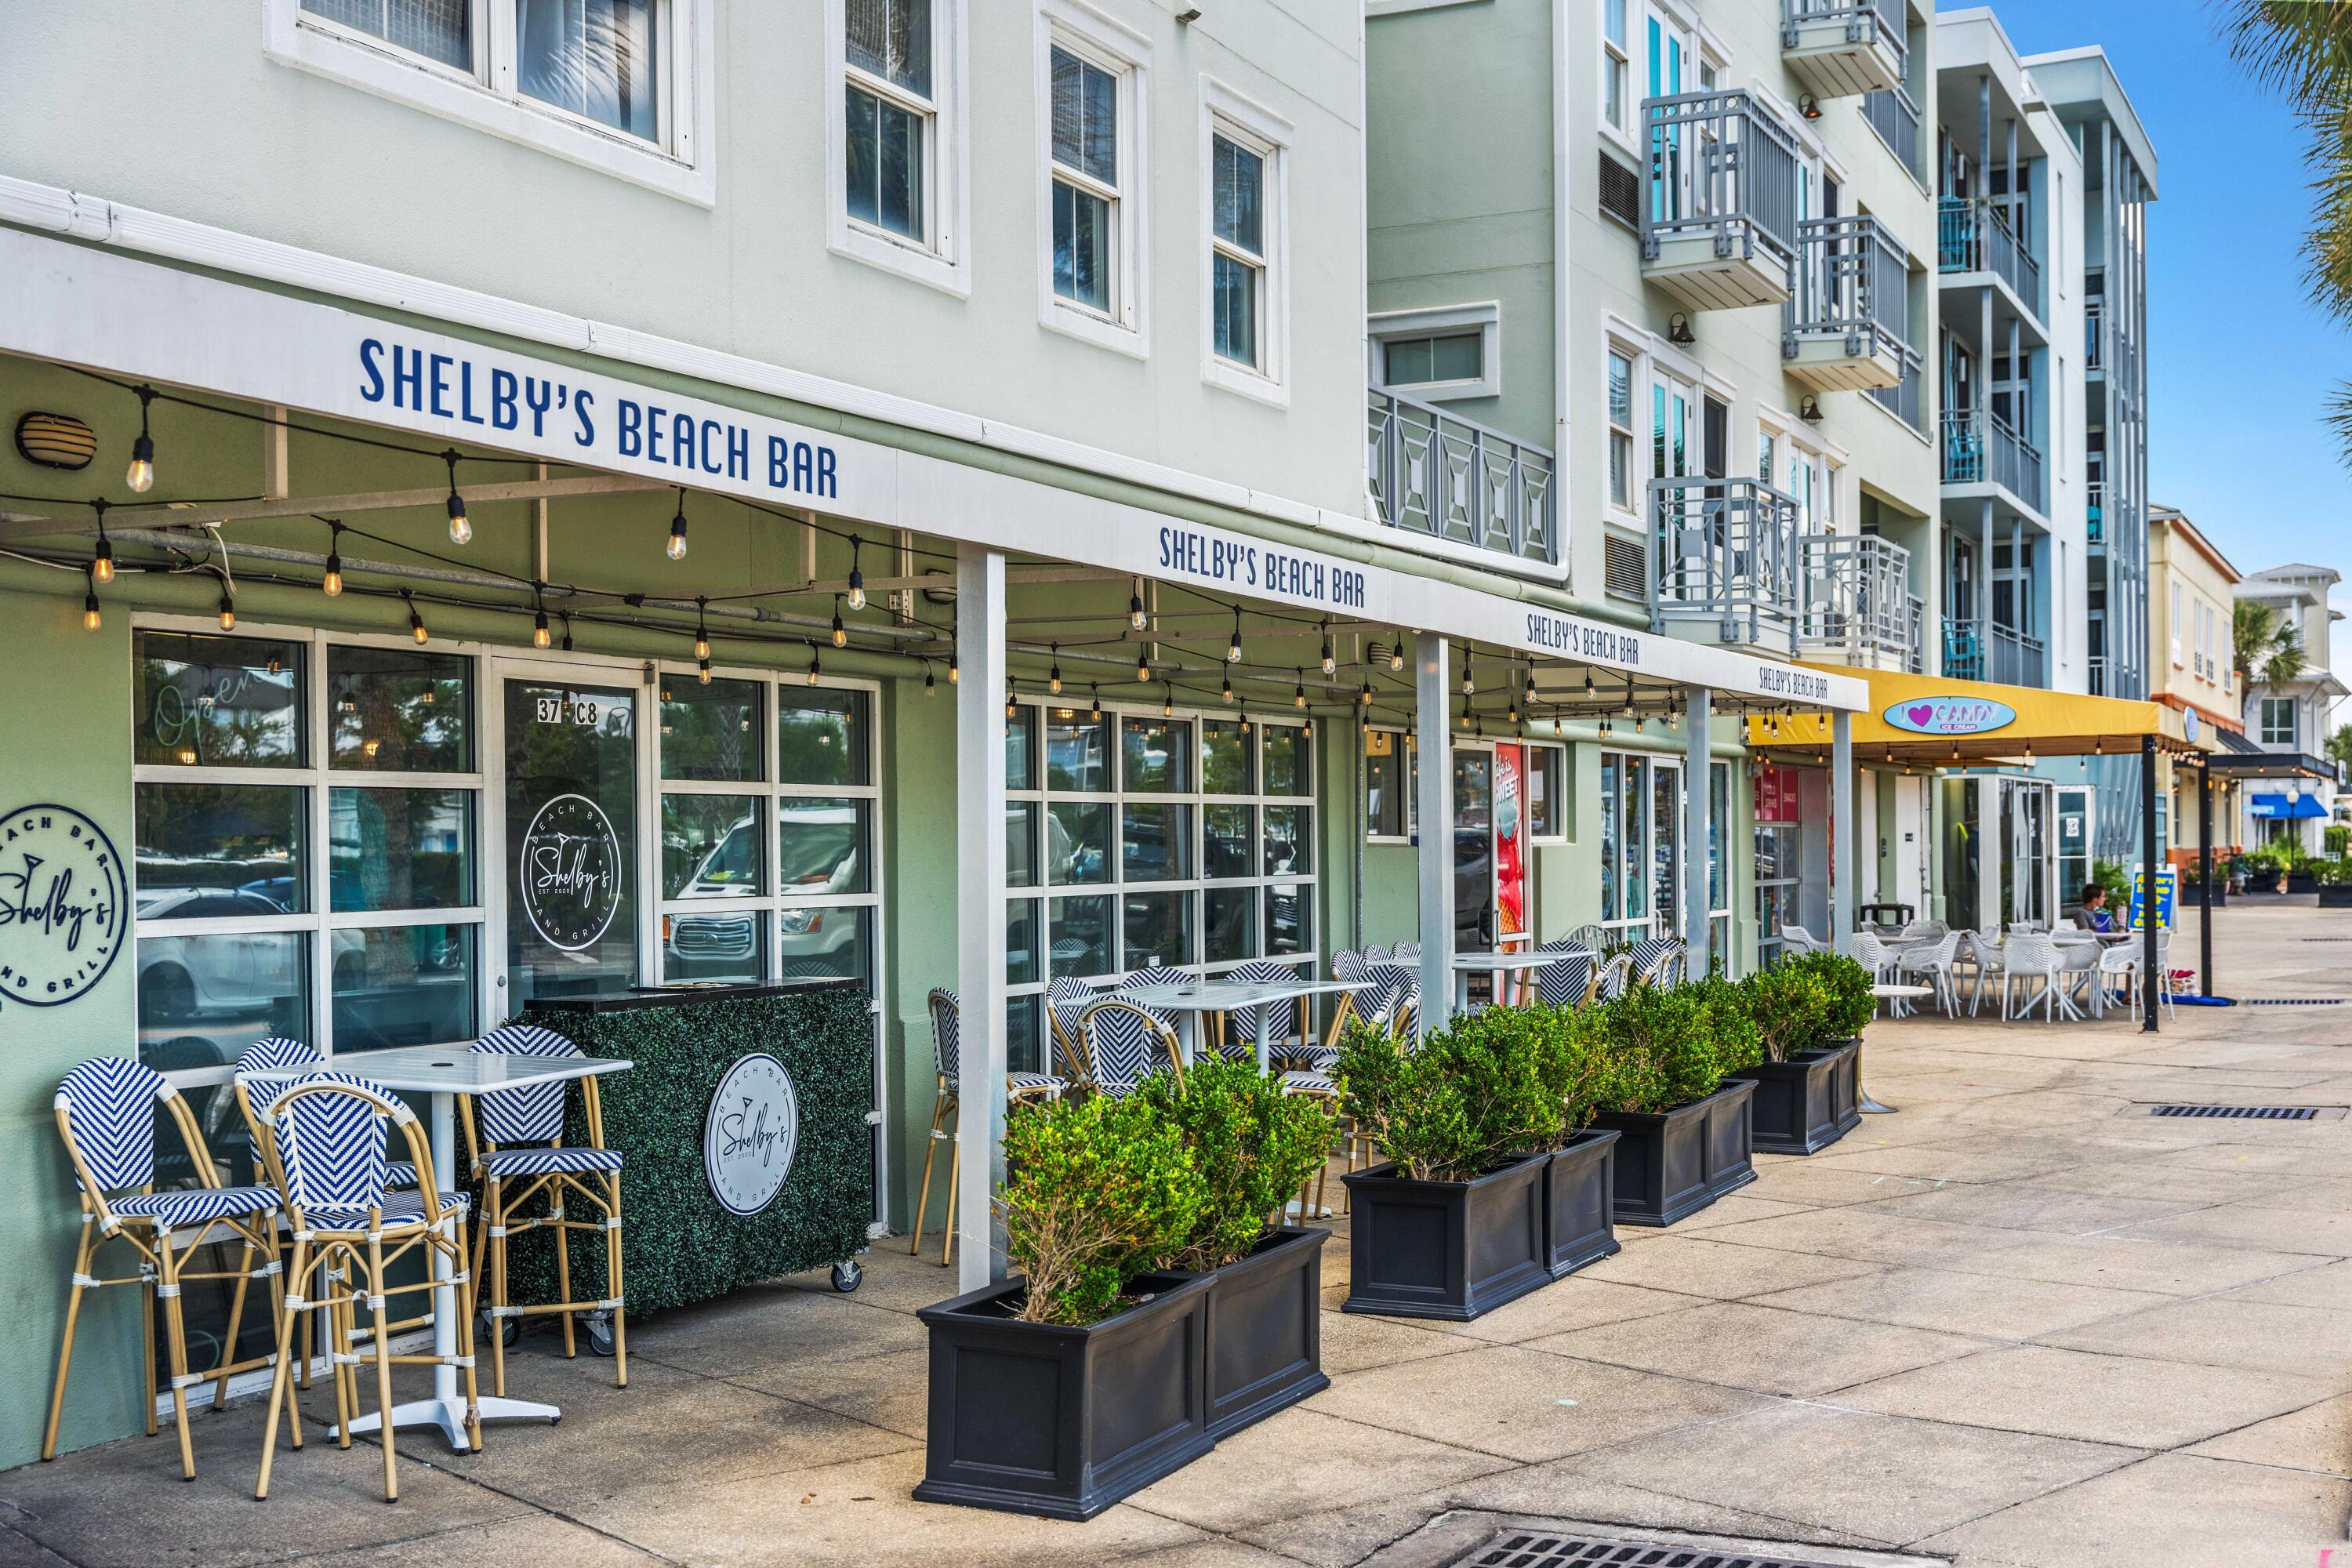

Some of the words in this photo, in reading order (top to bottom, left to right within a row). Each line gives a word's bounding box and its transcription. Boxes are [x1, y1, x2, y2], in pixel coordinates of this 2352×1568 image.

[360, 338, 595, 448] SHELBY'S
[619, 398, 749, 481] BEACH
[768, 435, 837, 499] BAR
[1160, 527, 1256, 586] SHELBY'S
[1265, 553, 1324, 601] BEACH
[1333, 568, 1364, 608] BAR
[1527, 613, 1578, 652] SHELBY'S
[1584, 628, 1616, 660] BEACH
[1621, 636, 1639, 665] BAR
[1759, 666, 1791, 693] SHELBY'S
[1793, 673, 1813, 697] BEACH
[1816, 677, 1828, 699] BAR
[539, 699, 560, 721] 37
[576, 702, 597, 724] C8
[1496, 774, 1519, 804] WEET
[0, 816, 52, 852] ACH
[71, 825, 108, 866] BAR
[532, 804, 575, 844] BEACH
[587, 811, 609, 843] BAR
[535, 832, 610, 909] Shelby's
[537, 908, 560, 936] AND
[572, 906, 608, 940] GRILL
[0, 966, 27, 989] ND
[47, 946, 108, 993] GRILL
[720, 1066, 758, 1113] BEACH
[768, 1067, 788, 1097] BAR
[721, 1097, 788, 1167] Shelby's
[738, 1151, 753, 1160] 2020
[721, 1177, 742, 1201] AND
[752, 1160, 785, 1202] GRILL
